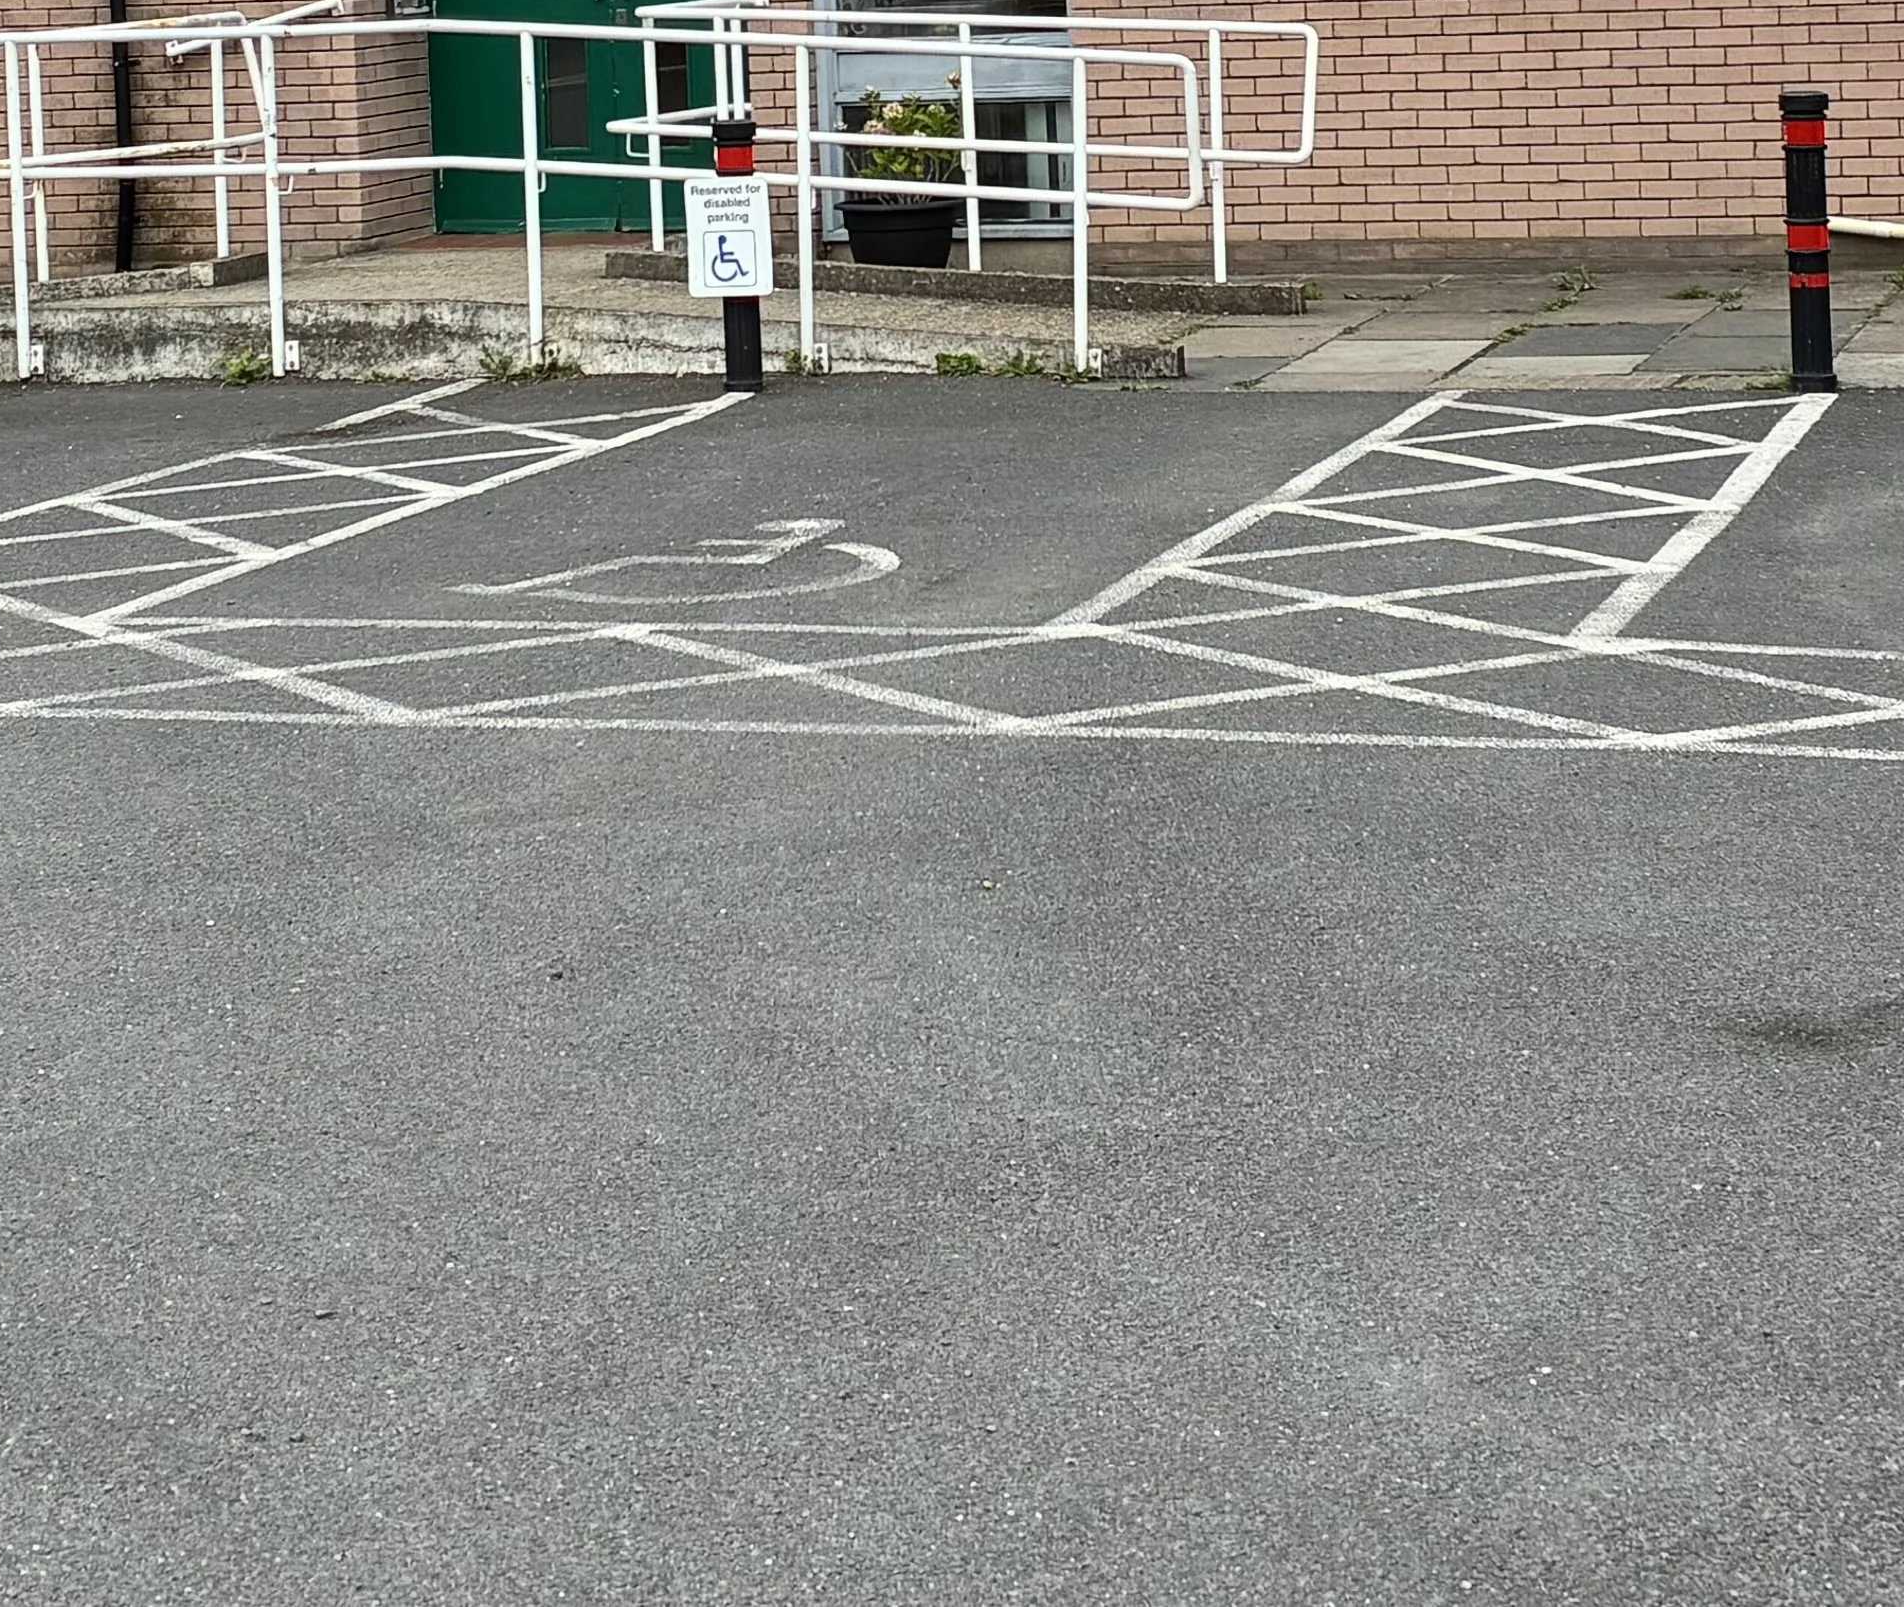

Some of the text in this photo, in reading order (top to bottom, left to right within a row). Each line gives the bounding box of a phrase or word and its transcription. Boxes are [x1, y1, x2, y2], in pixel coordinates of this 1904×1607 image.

[690, 184, 761, 196] Reserved for
[703, 197, 751, 209] disabled
[707, 212, 749, 225] parking
